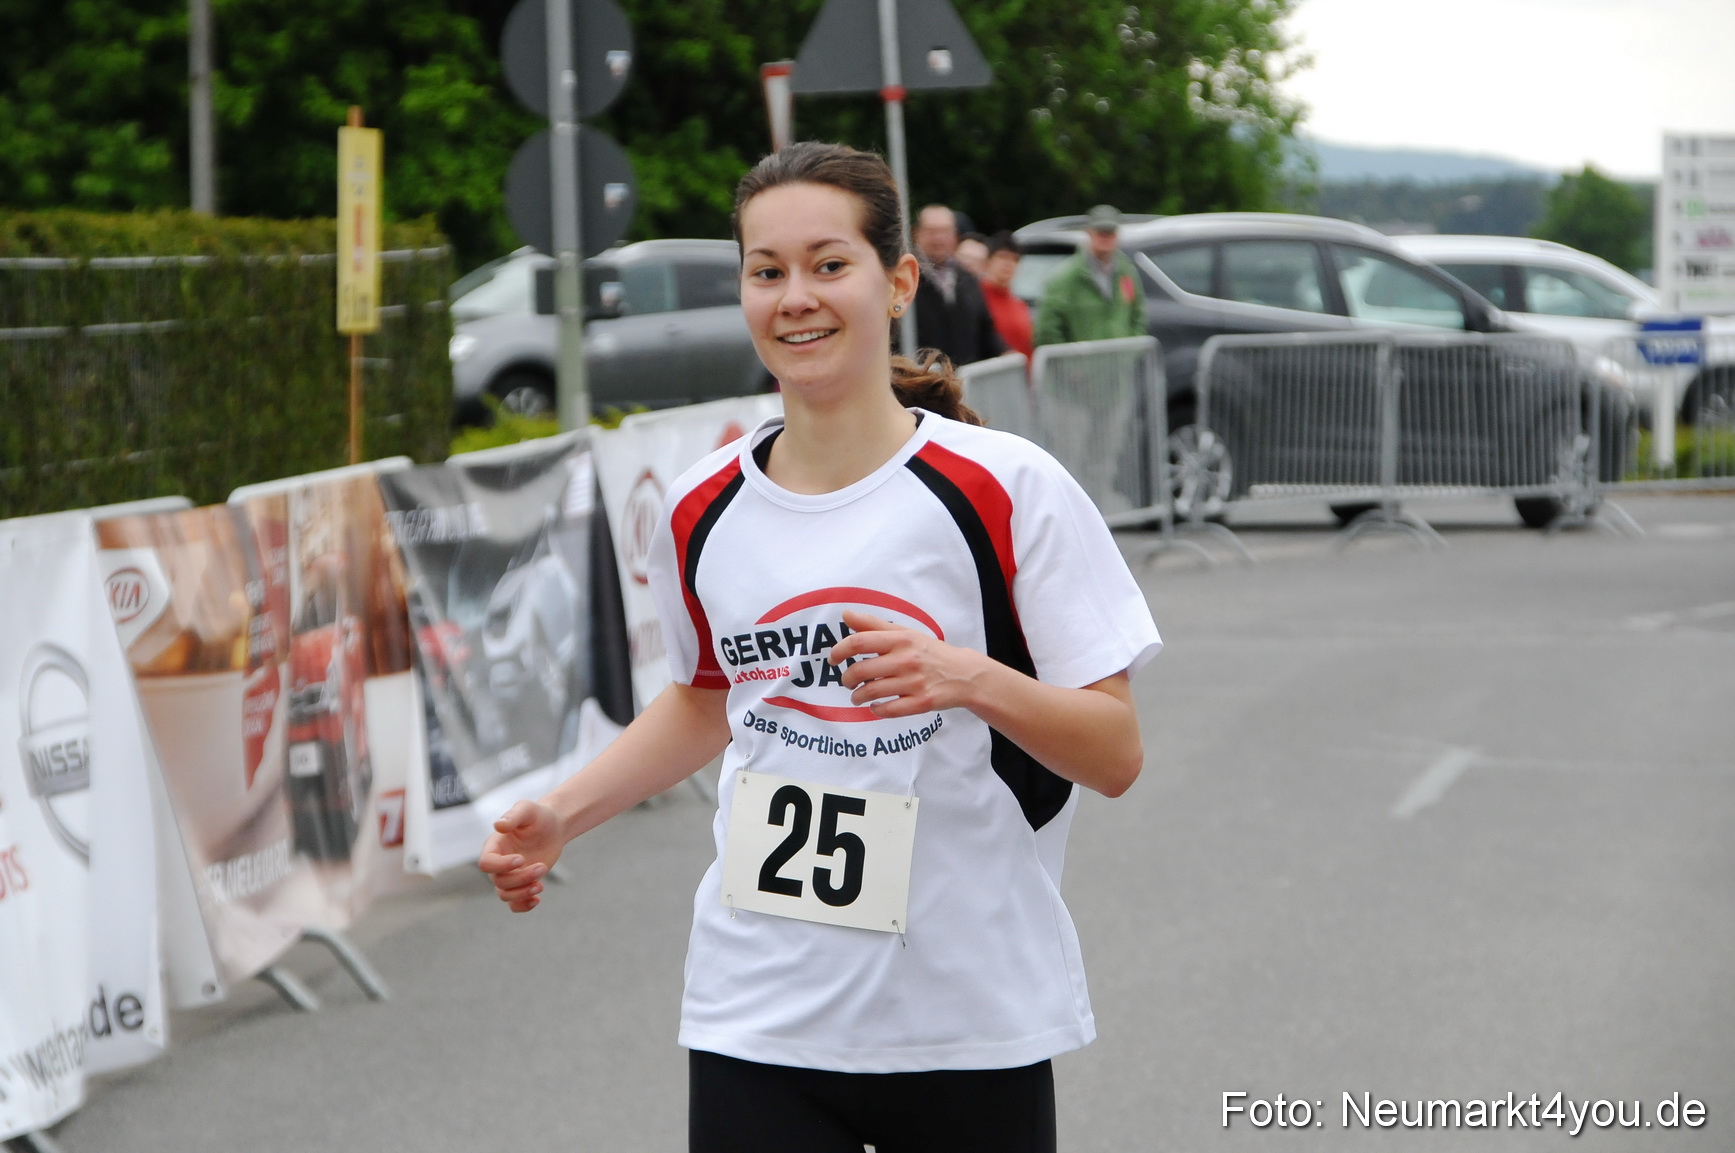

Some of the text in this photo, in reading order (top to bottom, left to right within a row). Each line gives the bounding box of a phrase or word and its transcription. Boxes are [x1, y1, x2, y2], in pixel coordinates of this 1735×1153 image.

[720, 621, 893, 666] GERHA
[732, 665, 790, 684] utohaus
[743, 709, 944, 758] Das sportliche Autohaus
[757, 784, 867, 907] 25
